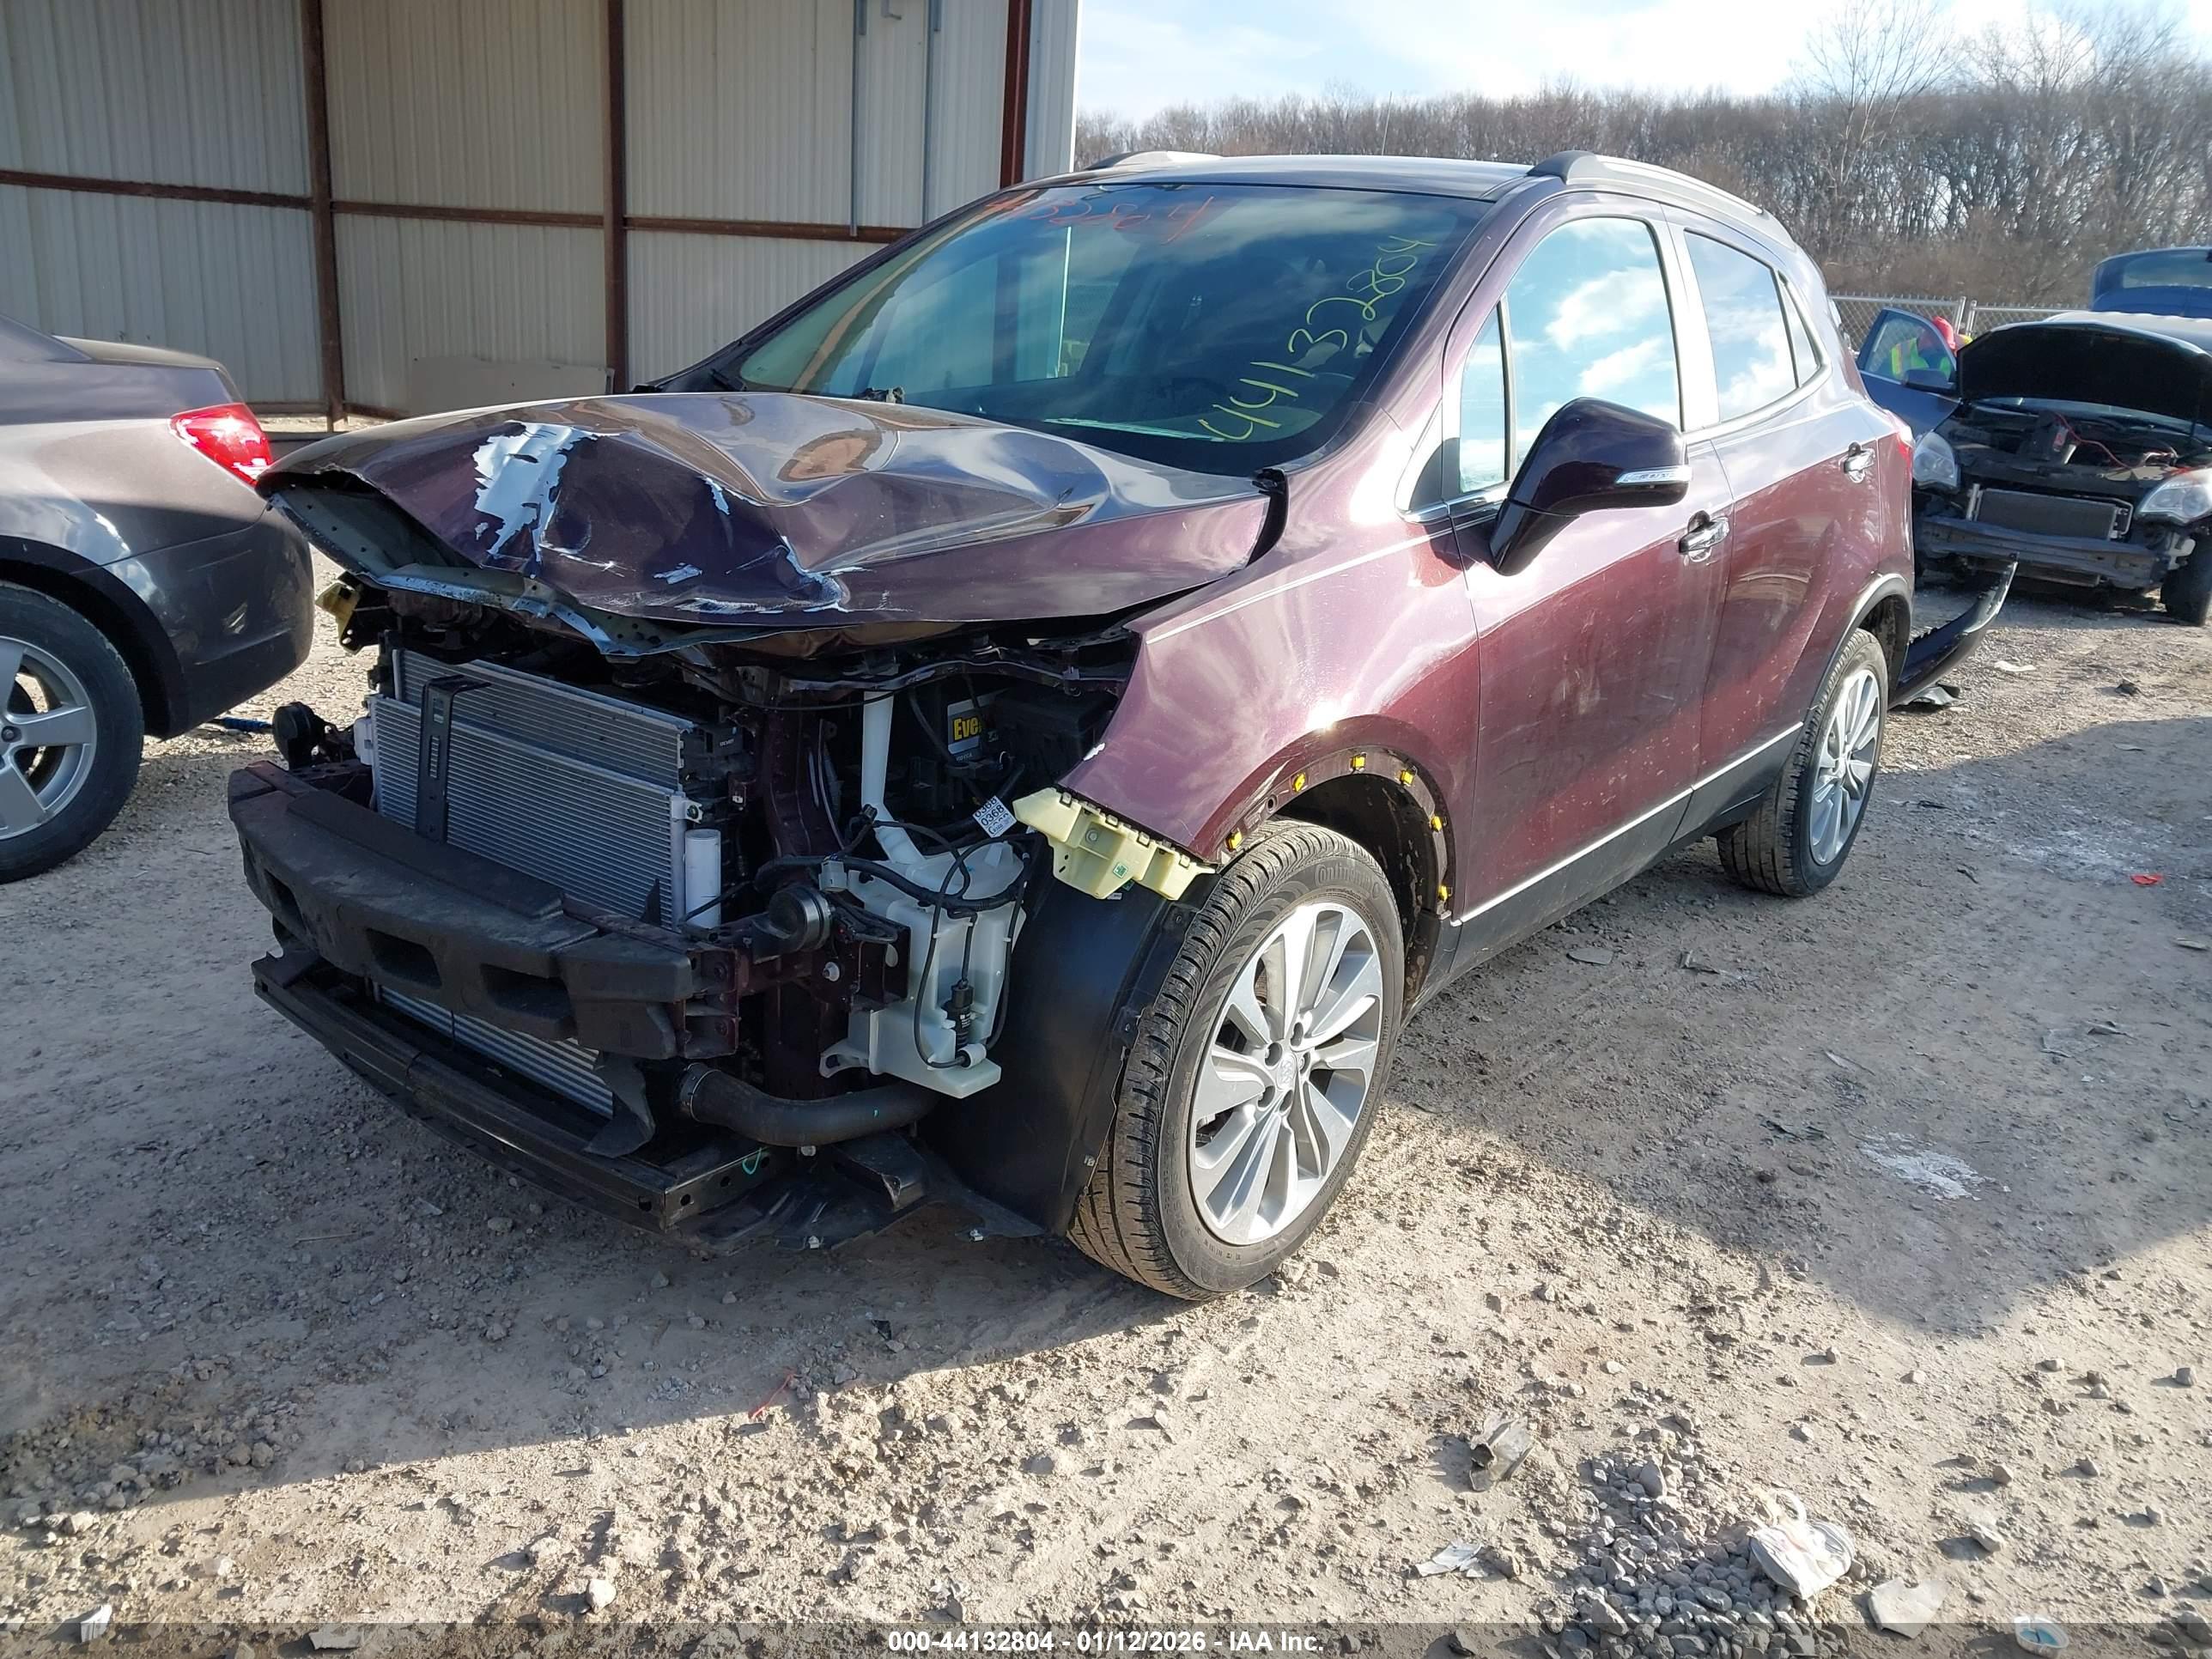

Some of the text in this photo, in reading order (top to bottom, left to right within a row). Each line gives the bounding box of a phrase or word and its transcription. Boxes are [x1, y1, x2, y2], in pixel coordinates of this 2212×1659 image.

[1197, 234, 1437, 441] 44132804
[953, 717, 981, 741] Eve
[981, 804, 1005, 826] 0368
